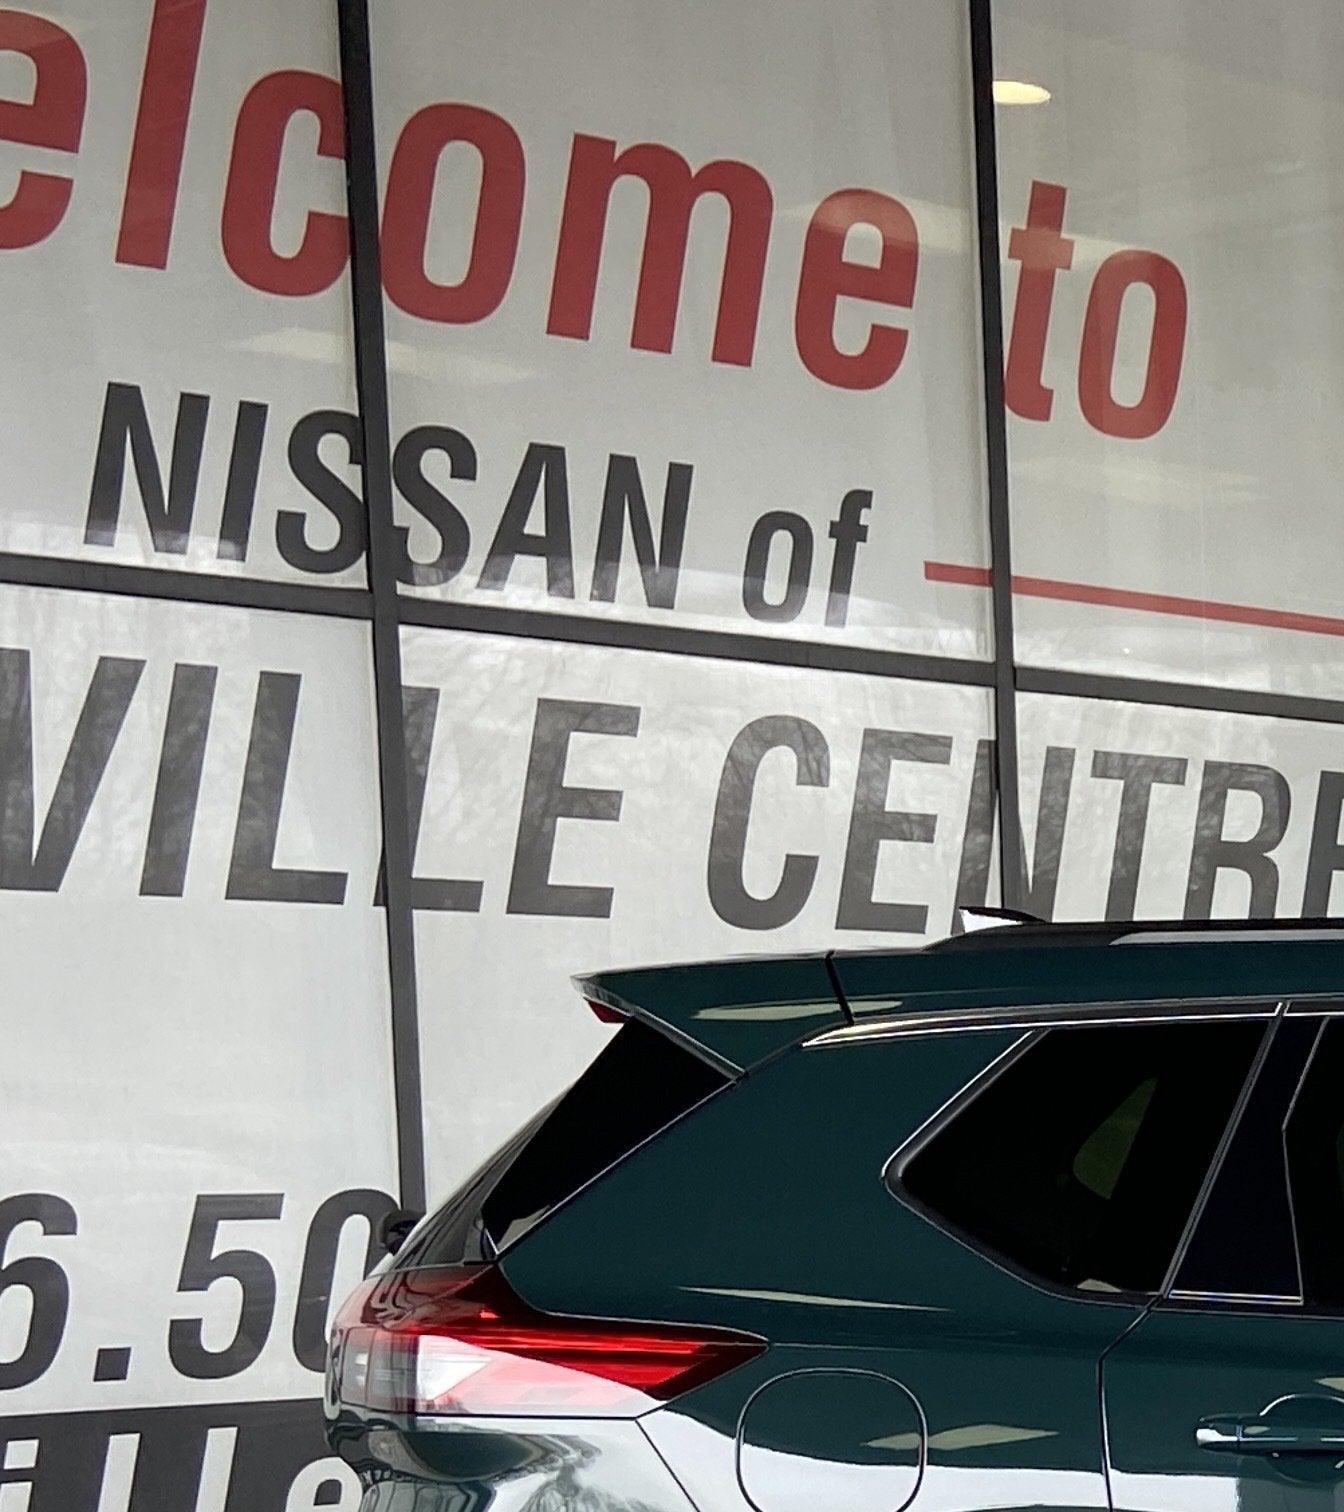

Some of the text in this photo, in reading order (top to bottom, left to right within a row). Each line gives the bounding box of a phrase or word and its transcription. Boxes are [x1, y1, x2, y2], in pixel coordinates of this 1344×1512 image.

[0, 0, 1188, 440] elcome to
[83, 381, 872, 628] NISSAN of
